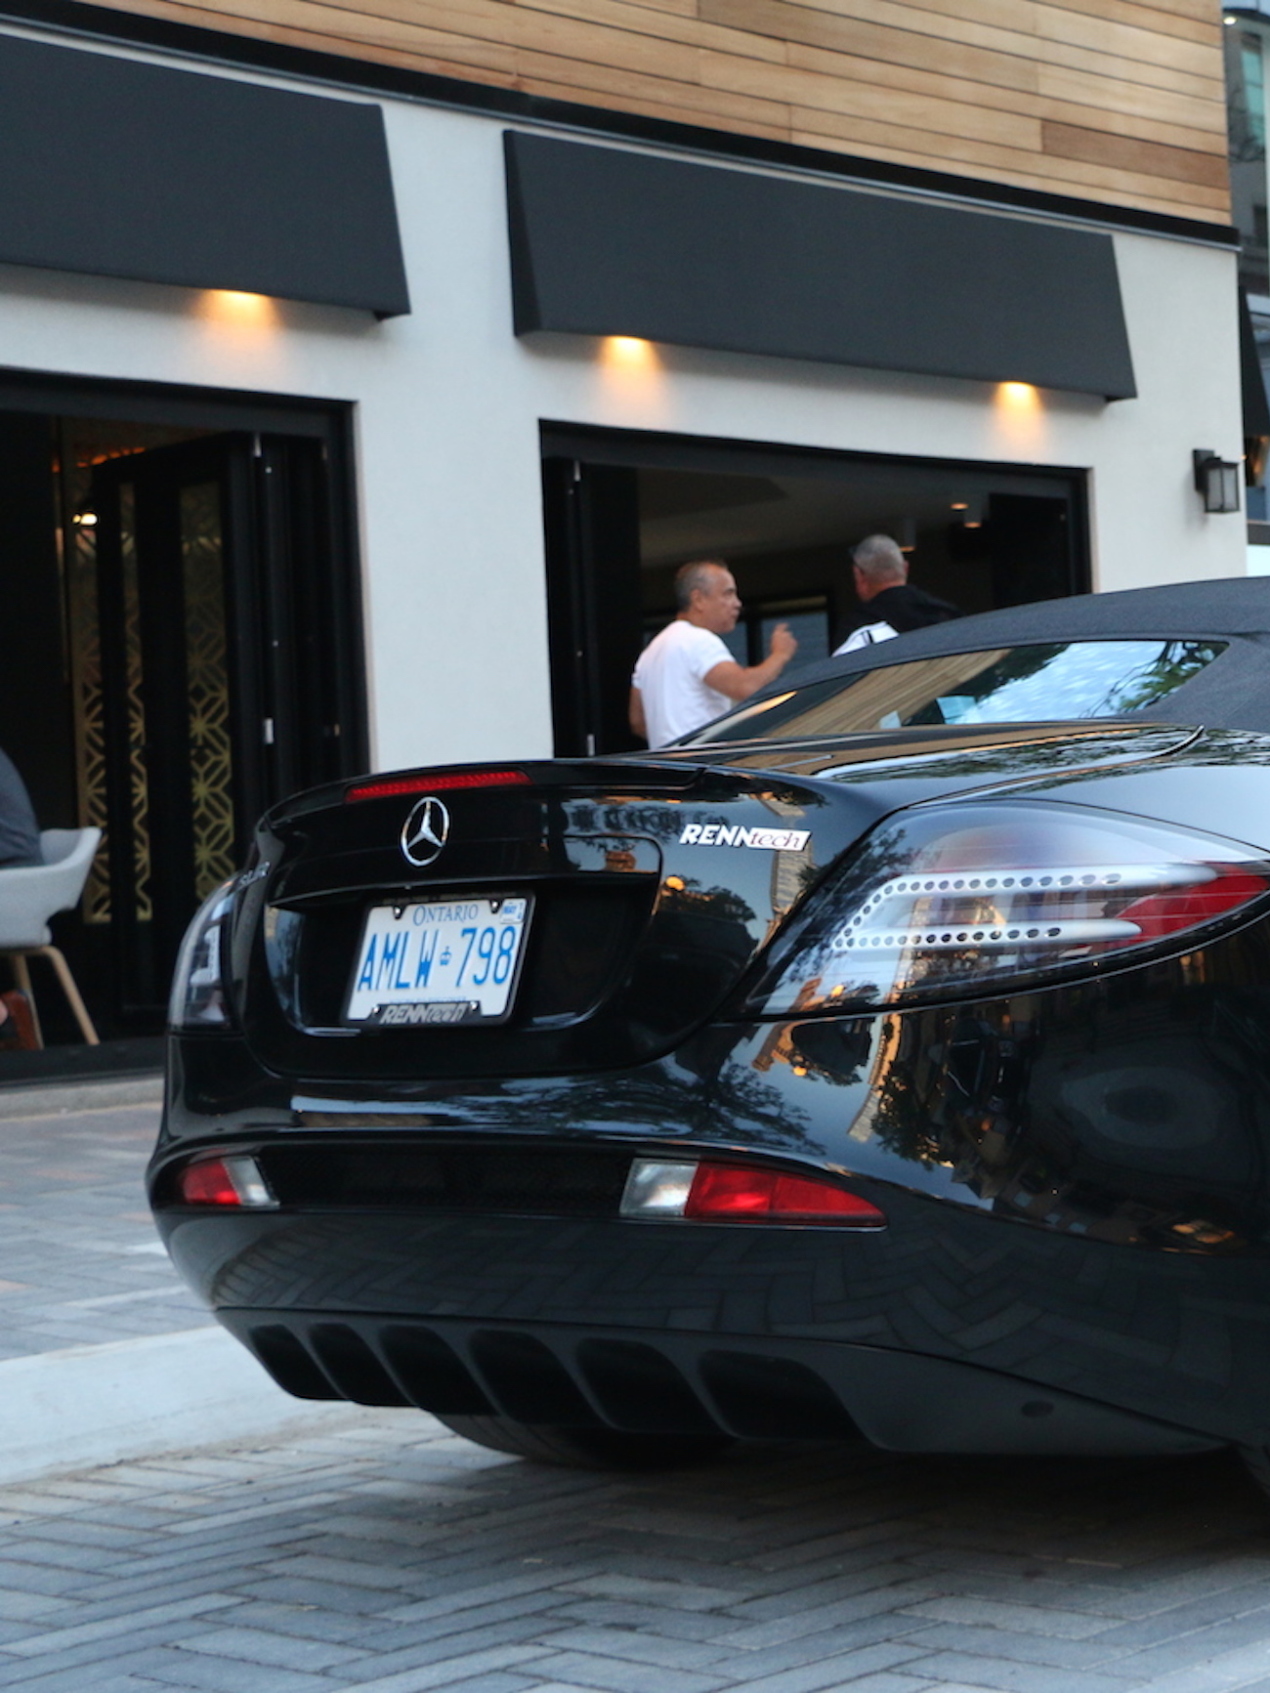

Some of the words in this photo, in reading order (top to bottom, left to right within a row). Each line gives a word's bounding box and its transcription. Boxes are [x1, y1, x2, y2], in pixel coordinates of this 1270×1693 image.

[679, 823, 810, 850] RENNtech
[412, 903, 479, 926] ONTARIO
[357, 928, 440, 992] AMLW
[456, 925, 517, 988] 798
